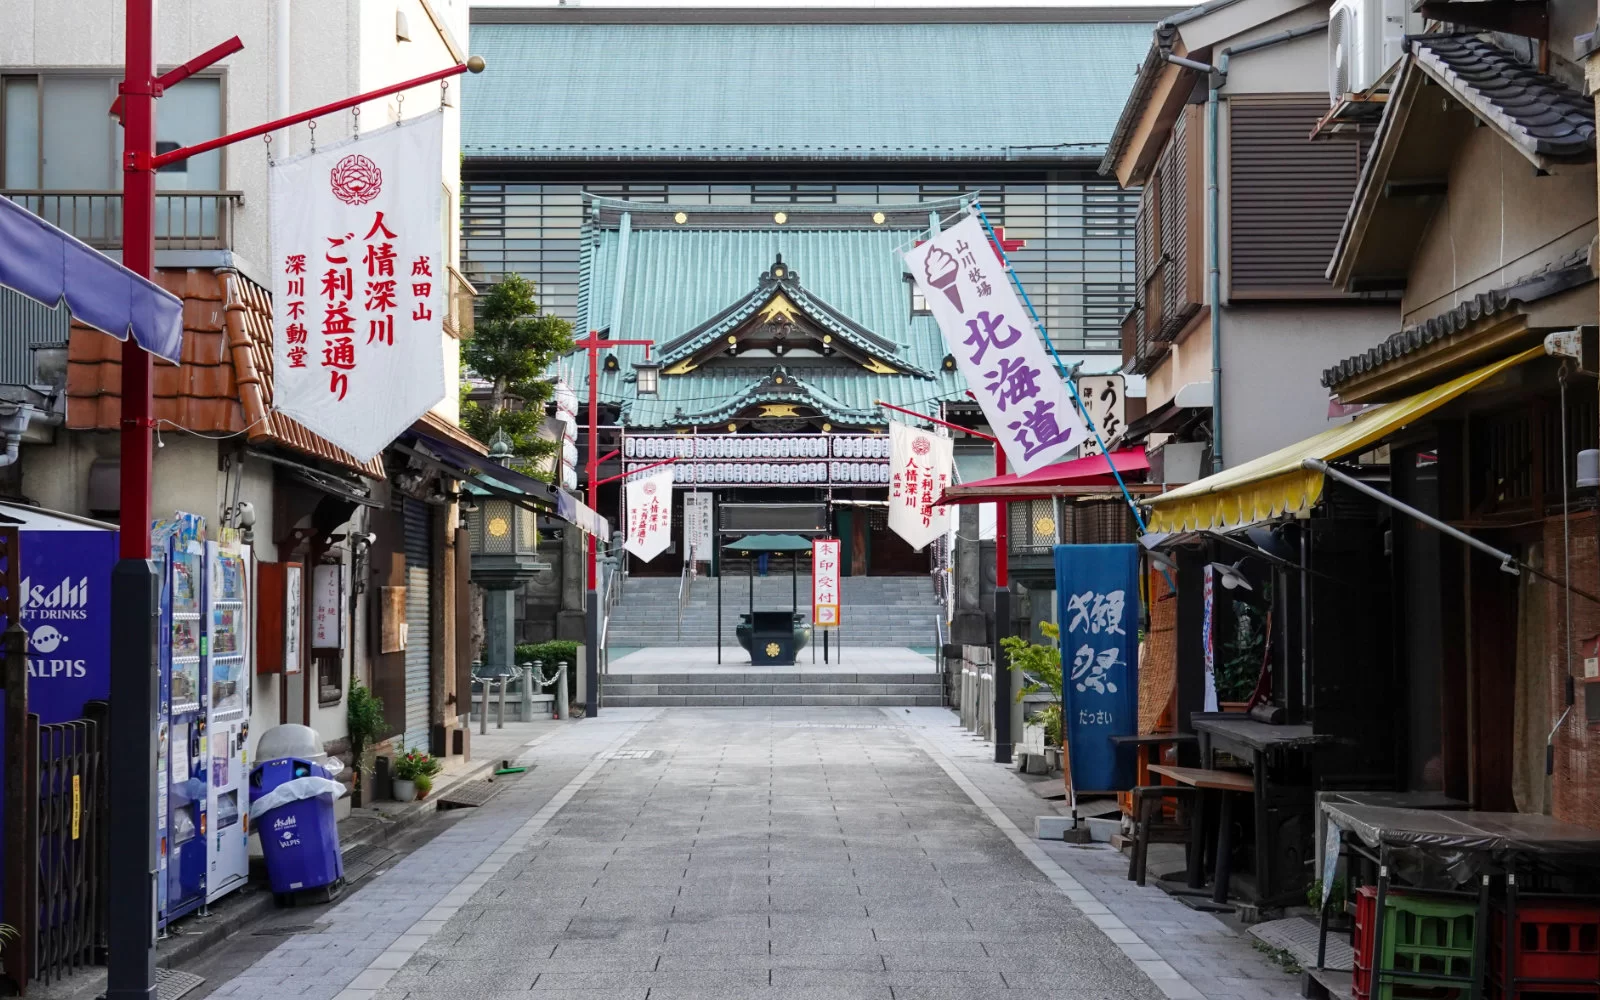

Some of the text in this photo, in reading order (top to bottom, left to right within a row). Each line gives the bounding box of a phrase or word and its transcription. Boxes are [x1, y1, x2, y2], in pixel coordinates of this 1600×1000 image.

[362, 210, 398, 347] 人情深川
[411, 255, 433, 322] 成田山
[956, 239, 992, 298] 山川牧場
[284, 254, 309, 369] 深川不動堂
[320, 232, 357, 402] ご利益通り
[963, 311, 1072, 462] 北海道
[1100, 380, 1121, 446] うな
[893, 472, 902, 498] 成田山
[904, 456, 919, 508] 人情深川
[919, 465, 935, 528] ご利益通り
[937, 473, 948, 517] 深川堂
[818, 543, 835, 603] 朱印受付
[40, 609, 87, 620] DRINKS
[27, 659, 87, 678] ALPIS
[1079, 709, 1113, 725] だっさい
